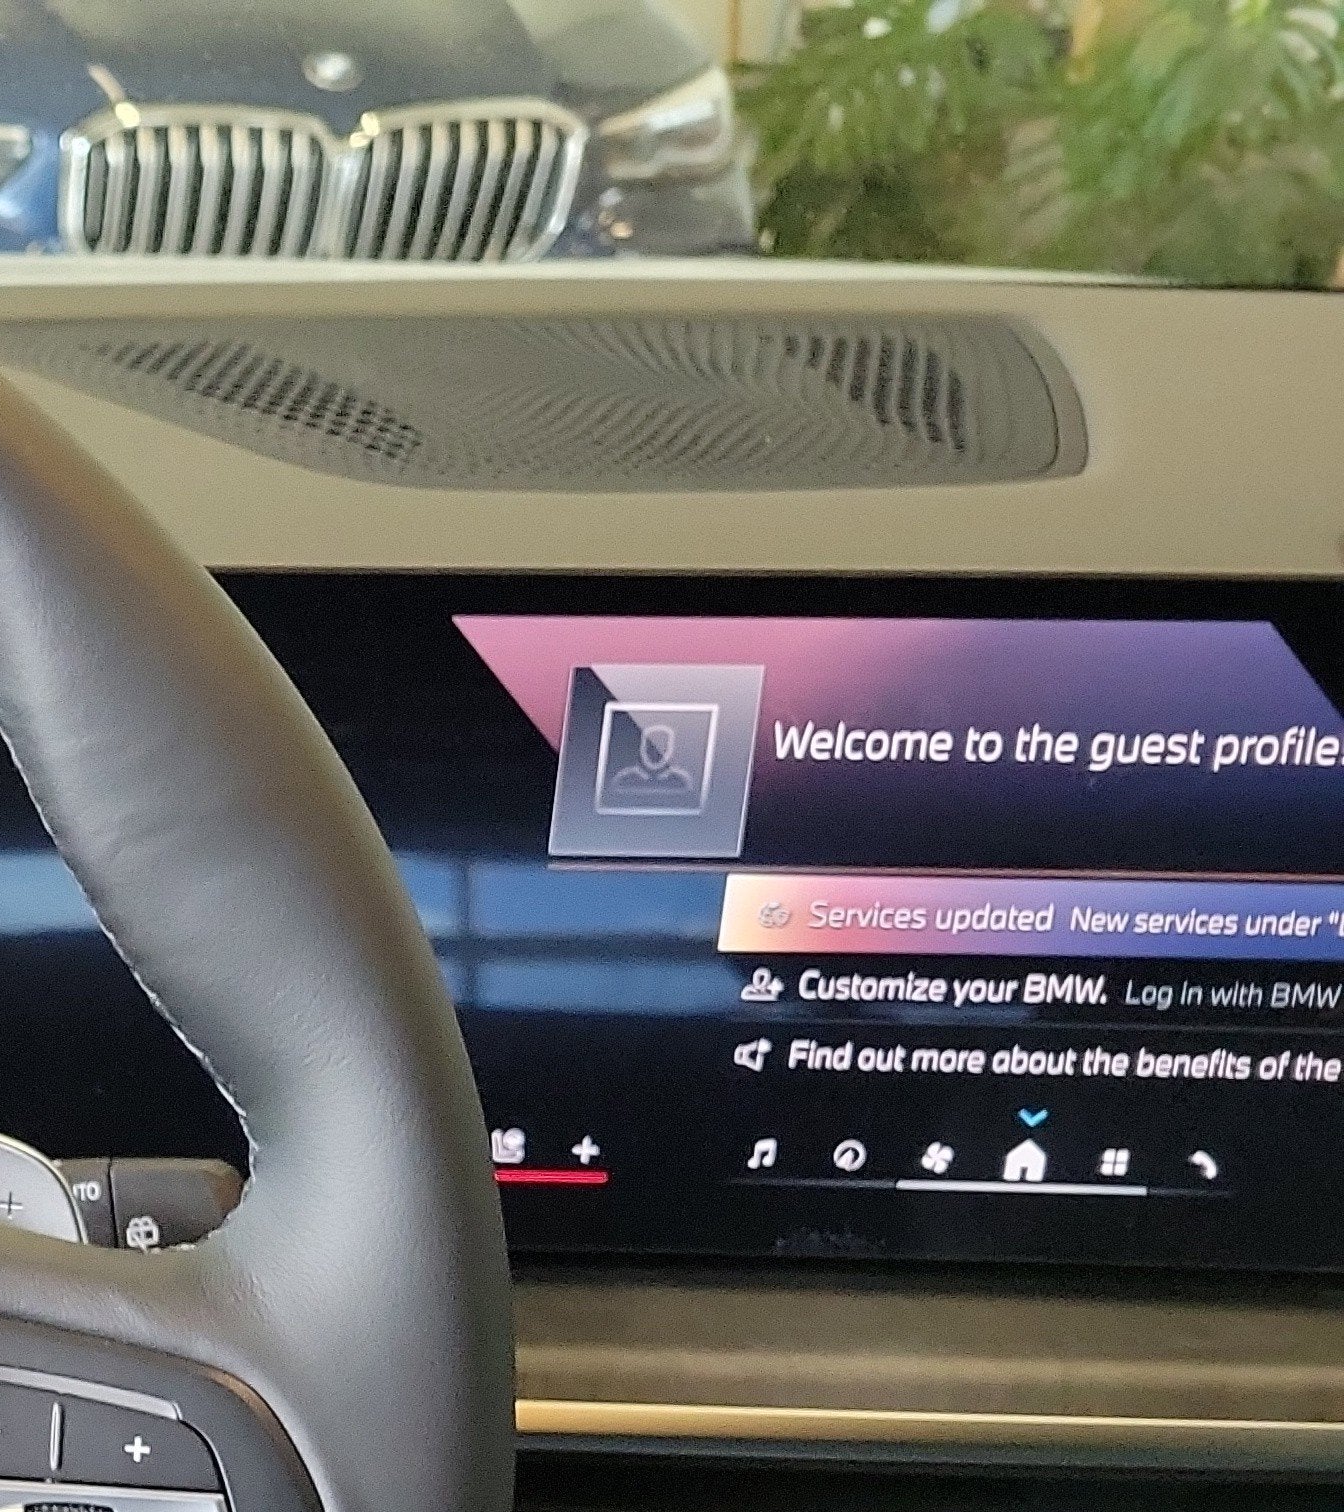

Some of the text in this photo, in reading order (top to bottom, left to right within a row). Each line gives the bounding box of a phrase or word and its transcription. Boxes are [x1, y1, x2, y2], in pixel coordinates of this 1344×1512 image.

[773, 720, 954, 762] Welcome
[964, 727, 1004, 763] to
[1014, 724, 1079, 764] the
[1088, 729, 1205, 772] guest
[807, 900, 927, 930] Services
[936, 902, 1054, 934] updated
[1070, 906, 1129, 932] New
[1133, 908, 1238, 936] services
[1245, 910, 1322, 937] under
[798, 968, 1343, 1011] Customize your BMW. Log in with BMW
[788, 1038, 1342, 1082] Find out more about the benefits of the
[72, 1181, 101, 1201] TO
